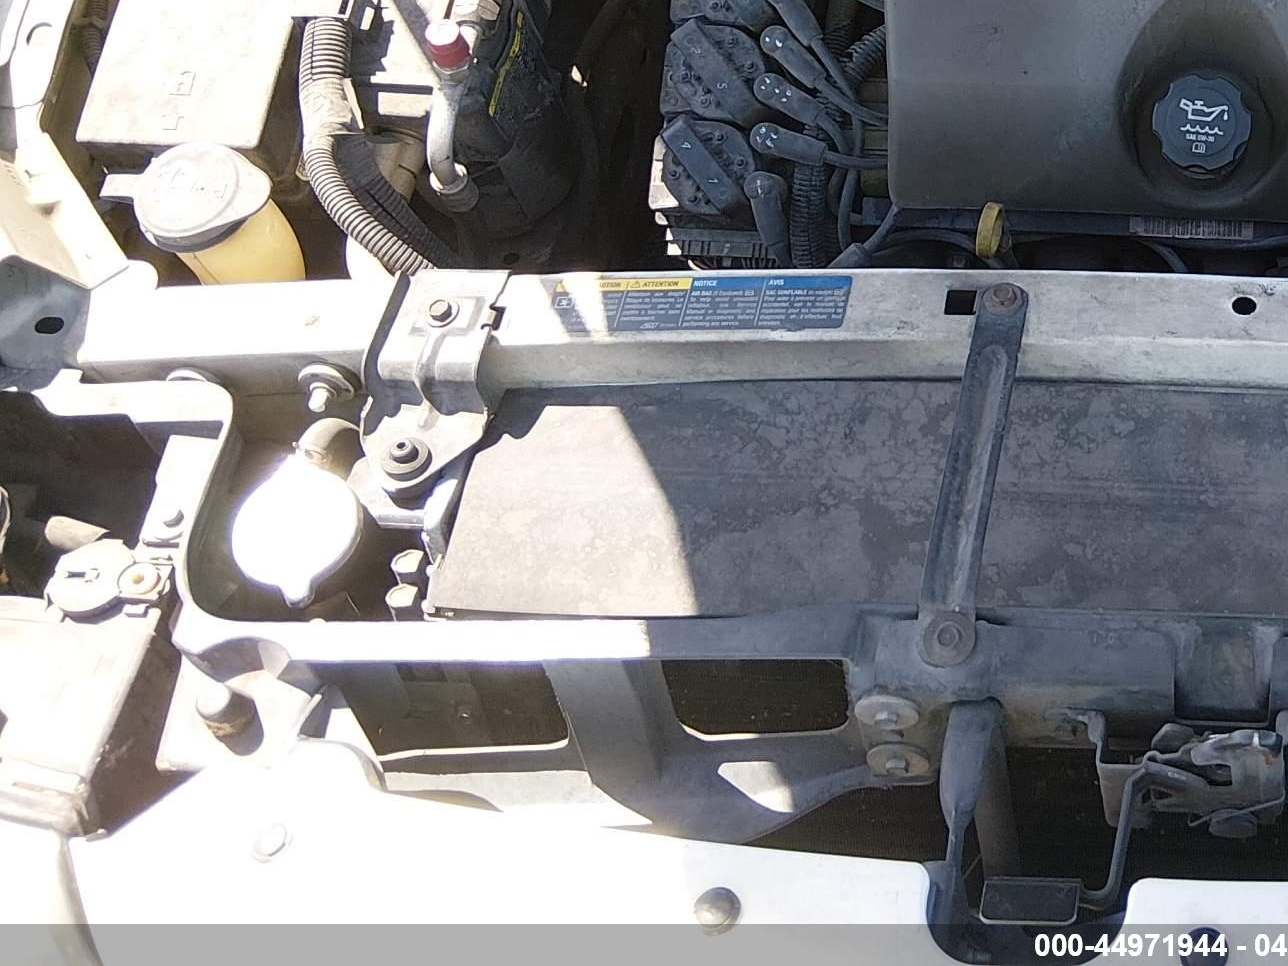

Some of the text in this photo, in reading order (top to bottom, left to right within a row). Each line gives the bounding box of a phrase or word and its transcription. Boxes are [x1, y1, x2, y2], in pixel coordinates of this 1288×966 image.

[716, 82, 728, 90] 5
[681, 141, 692, 150] 4
[642, 280, 680, 288] ATTENTION
